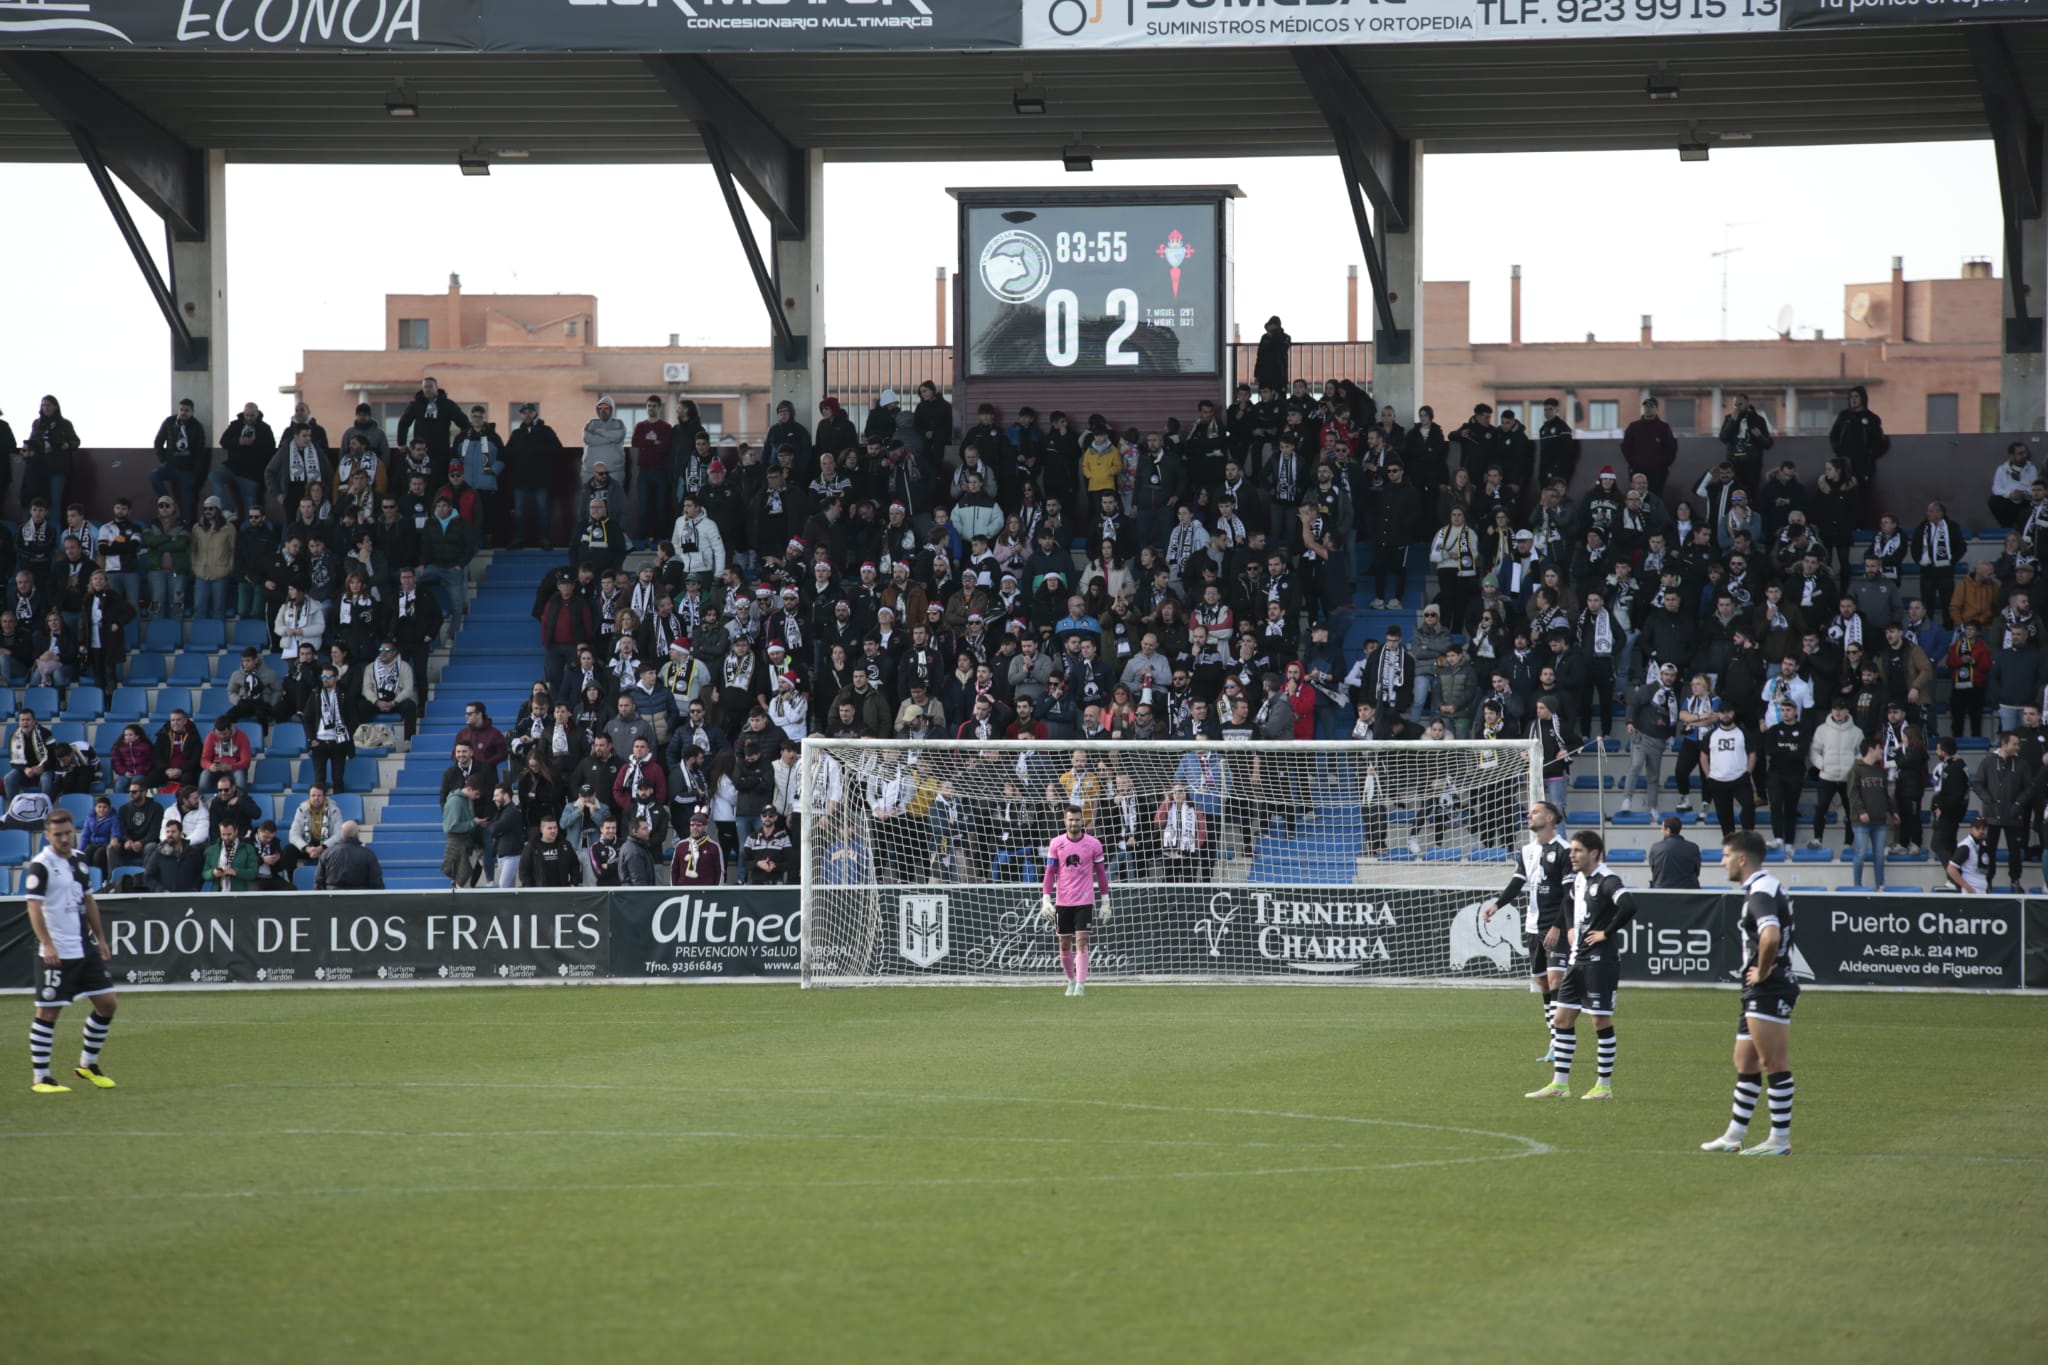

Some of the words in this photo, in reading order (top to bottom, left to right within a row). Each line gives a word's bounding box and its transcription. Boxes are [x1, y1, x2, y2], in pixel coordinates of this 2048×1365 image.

[1477, 0, 1548, 25] TLF.
[1557, 0, 1625, 23] 923
[1635, 0, 1682, 21] 99
[1690, 0, 1727, 19] 15
[1146, 20, 1266, 36] SUMINISTROS
[1270, 16, 1350, 33] MÉDICOS
[1354, 18, 1365, 31] Y
[1369, 16, 1473, 32] ORTOPEDIA
[1056, 231, 1128, 263] 83:55
[1045, 289, 1079, 367] 0
[1105, 288, 1139, 365] 2
[1718, 738, 1735, 751] DC
[1250, 892, 1397, 925] TERNERA
[111, 907, 234, 955] RDÓN
[257, 917, 311, 953] DE
[330, 916, 407, 952] LOS
[427, 913, 600, 951] FRAILES
[1831, 911, 1911, 934] Puerto
[1918, 912, 2008, 935] Charro
[675, 945, 748, 958] PREVENCION
[751, 945, 759, 957] Y
[1258, 926, 1391, 960] CHARRA
[1863, 944, 1899, 957] A-62
[1901, 946, 1925, 959] p.k.
[1928, 946, 1953, 958] 214
[1955, 947, 1978, 958] MD
[645, 961, 670, 973] Tfno.
[672, 961, 723, 972] 923616845
[1648, 957, 1710, 975] grupo
[1839, 961, 1920, 974] Aldeanueva
[1922, 962, 1939, 974] de
[1943, 963, 2003, 978] Figueroa
[44, 970, 62, 987] 15
